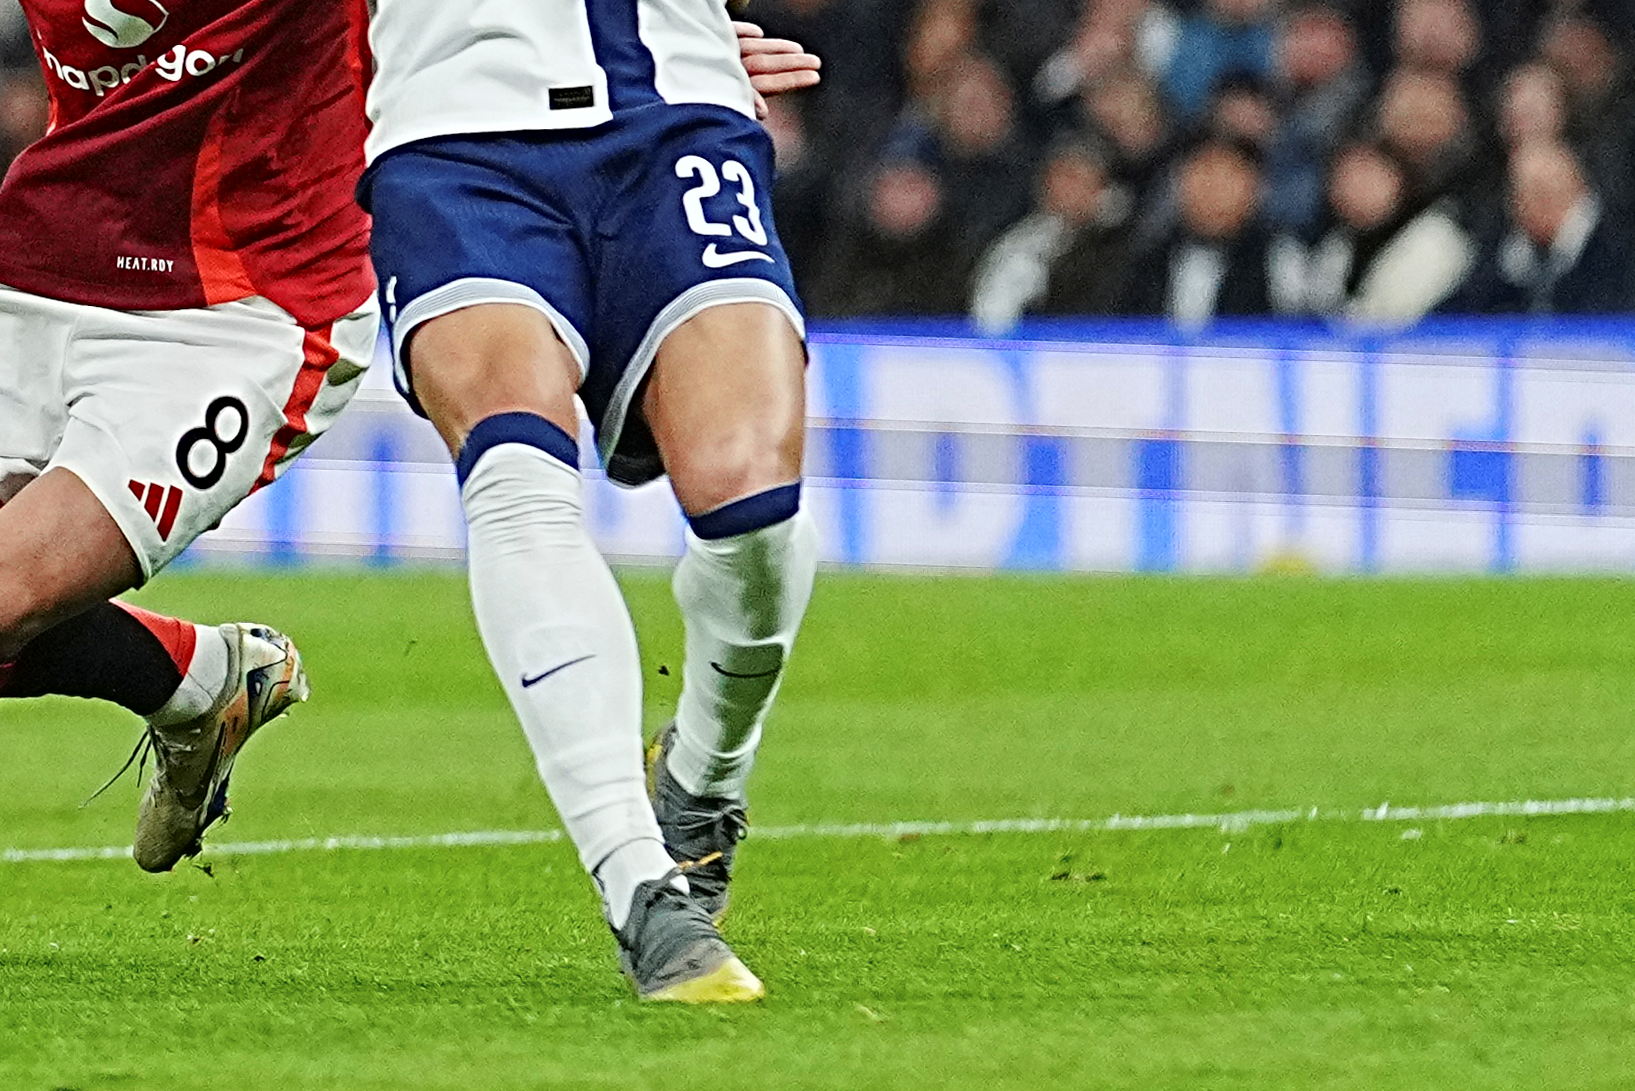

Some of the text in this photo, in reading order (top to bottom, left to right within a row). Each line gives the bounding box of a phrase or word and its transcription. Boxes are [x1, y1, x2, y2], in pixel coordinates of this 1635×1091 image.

[674, 154, 768, 247] 23
[116, 255, 174, 273] HEAT.RDY
[175, 394, 249, 490] 8
